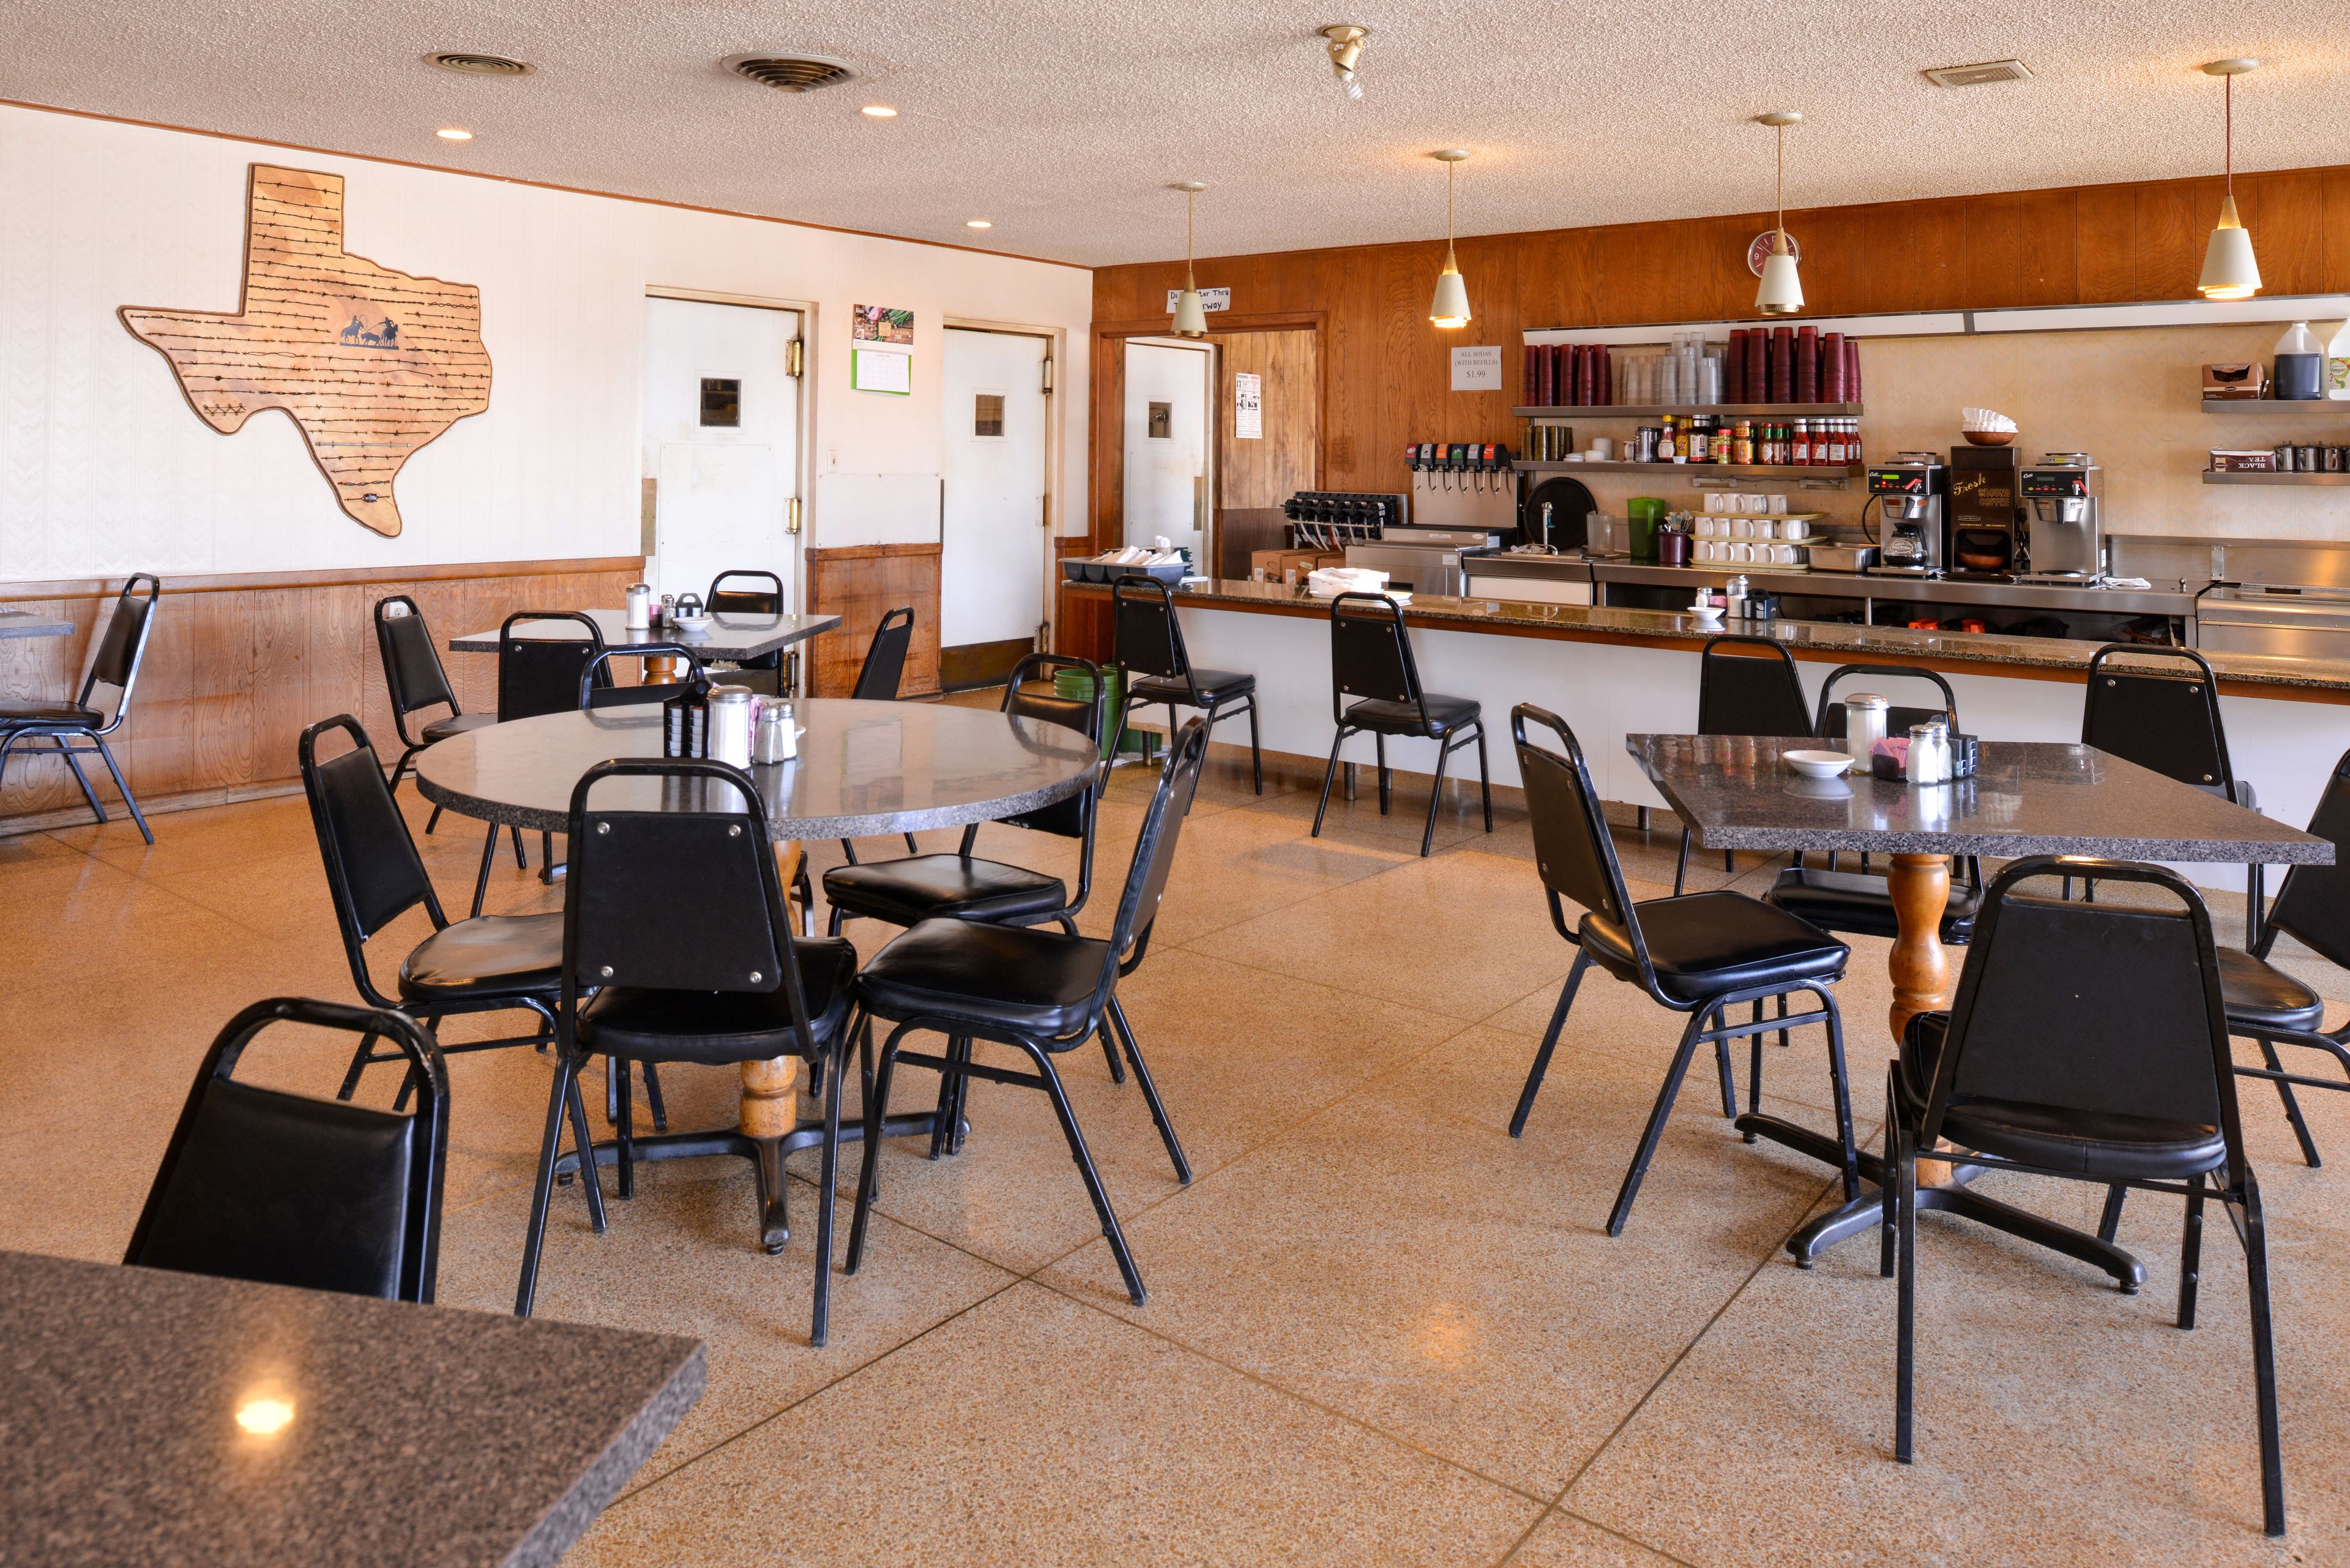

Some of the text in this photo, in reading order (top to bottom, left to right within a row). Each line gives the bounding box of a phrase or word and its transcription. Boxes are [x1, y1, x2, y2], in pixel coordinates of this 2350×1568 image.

[1953, 472, 1986, 496] Fresh
[1978, 488, 2011, 498] GROUND
[1979, 498, 2010, 507] COFFEE
